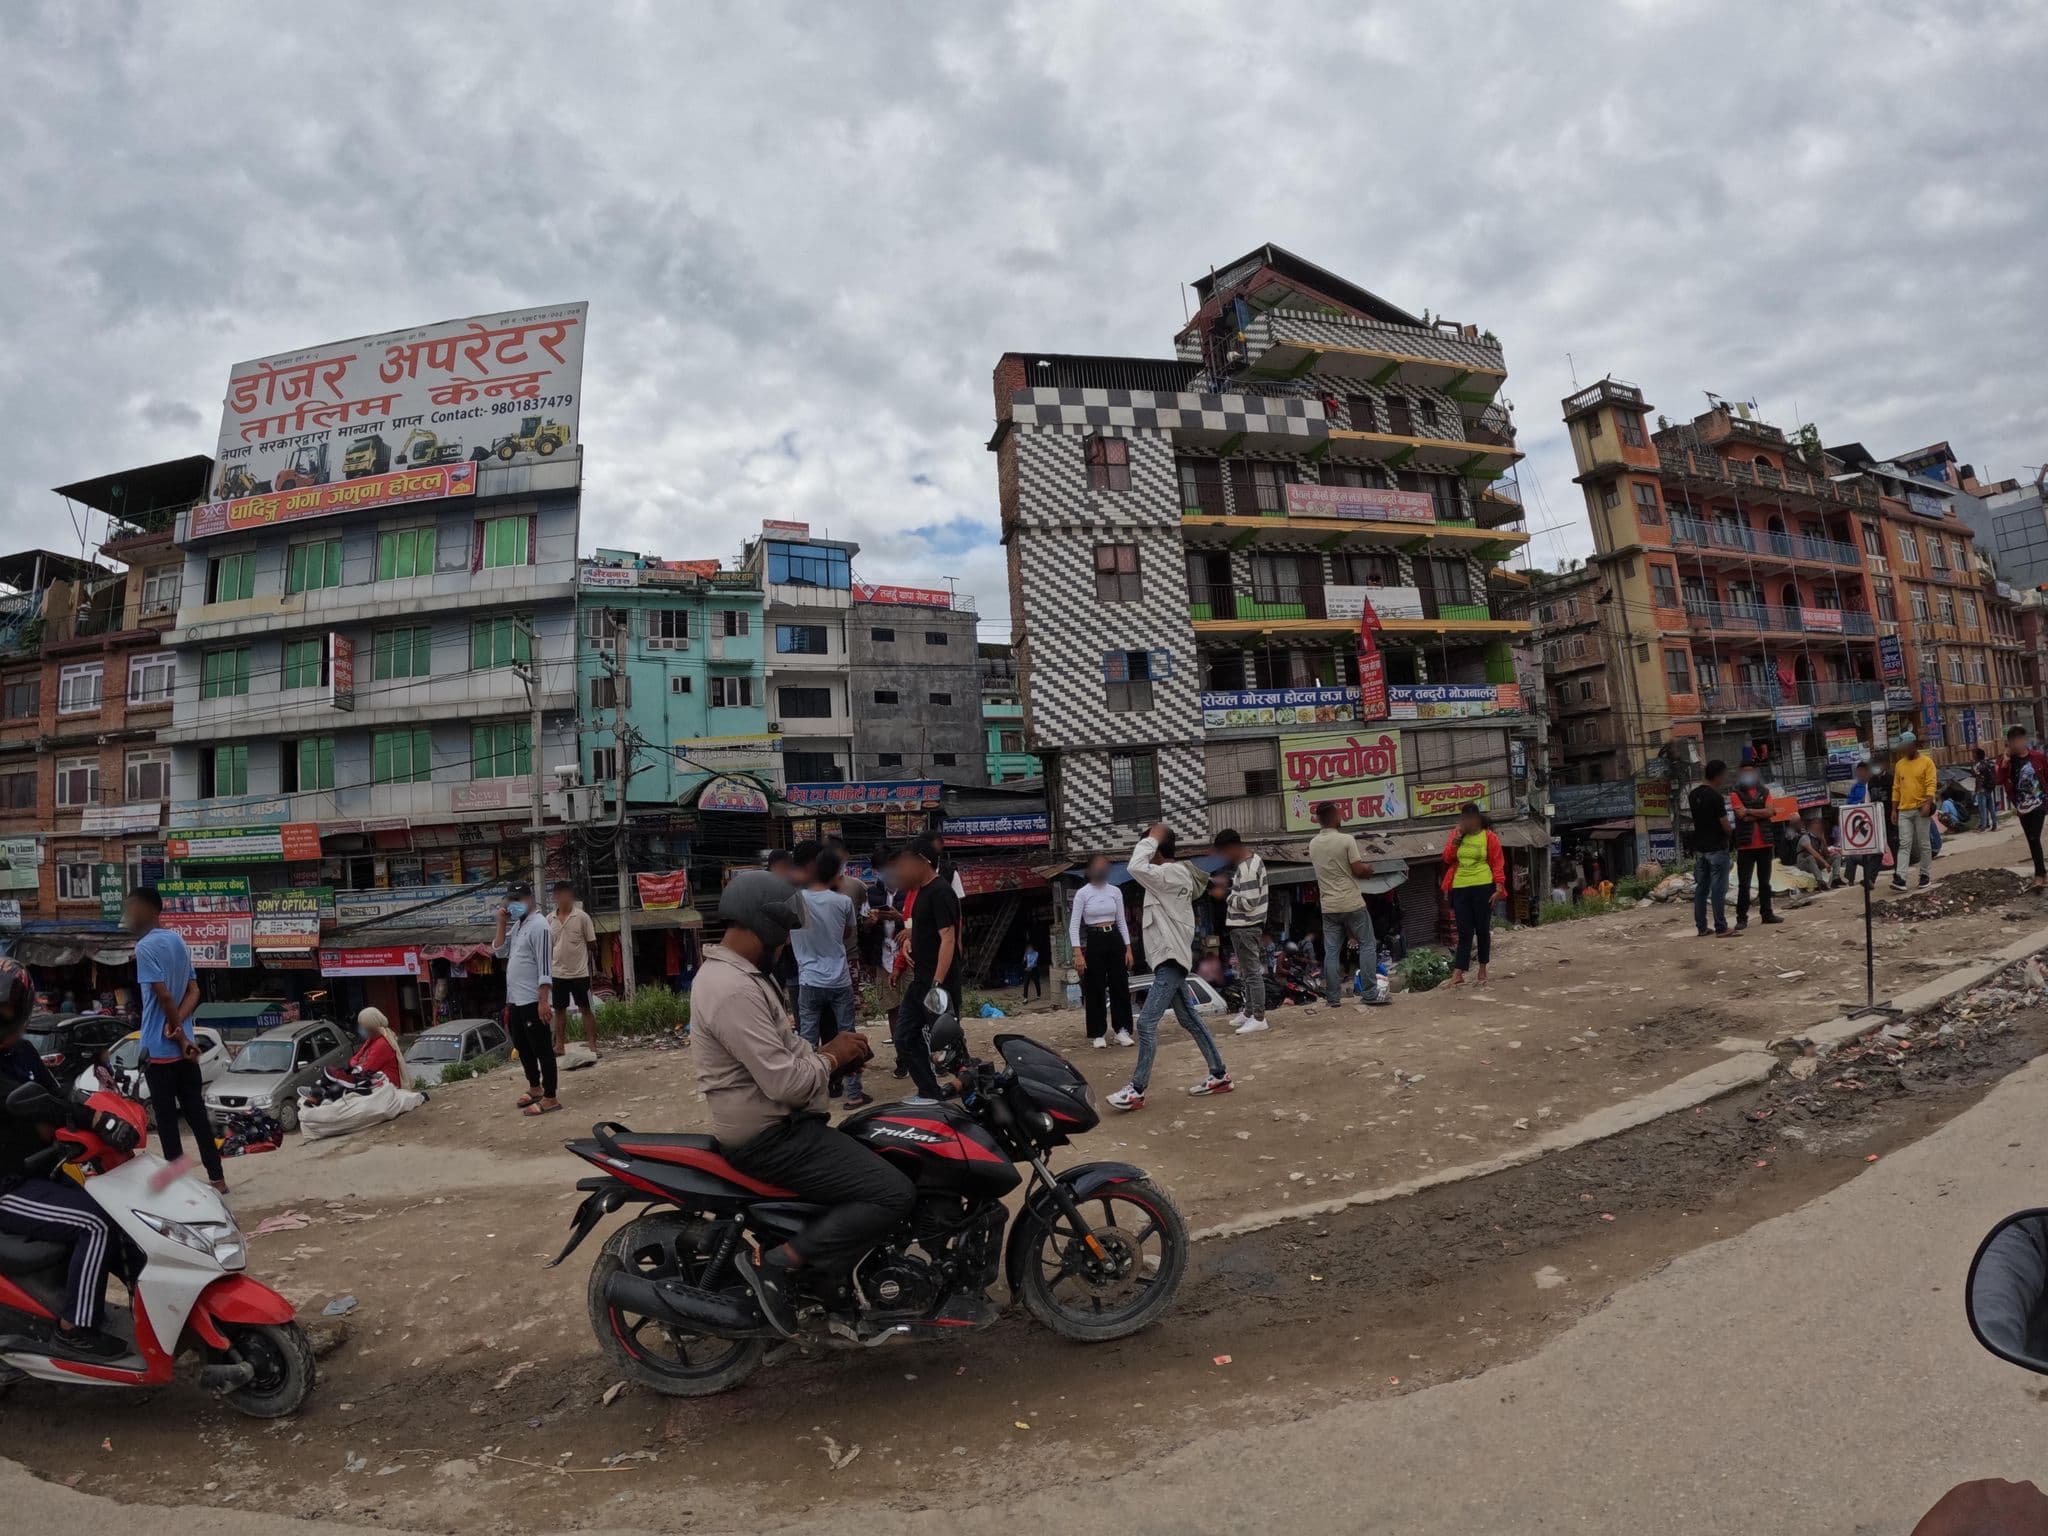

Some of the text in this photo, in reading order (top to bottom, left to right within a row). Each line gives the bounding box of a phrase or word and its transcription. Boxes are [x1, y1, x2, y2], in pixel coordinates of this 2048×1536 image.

[230, 318, 578, 414] डोजर अपरेटर
[240, 370, 552, 443] तालिम केन्द्र
[221, 445, 252, 461] नेपाल
[259, 430, 331, 454] सरकारद्वारा
[338, 420, 385, 438] मान्यता
[392, 414, 424, 430] प्राप्त
[491, 394, 573, 415] 9801837479
[286, 490, 323, 510] गंगा
[328, 483, 382, 505] जमुना
[389, 472, 443, 496] होटल
[1202, 693, 1238, 707] रोयल
[1242, 691, 1281, 705] गोरखा
[1284, 689, 1317, 703] होटल
[1320, 691, 1342, 702] लज
[1415, 687, 1446, 701] तन्दुरी
[1449, 686, 1497, 699] भोजनालय
[1285, 735, 1397, 791] फुल्चोकी
[1357, 795, 1385, 817] बार
[256, 898, 318, 912] SONY OPTICAL
[195, 924, 227, 937] स्टुडियो
